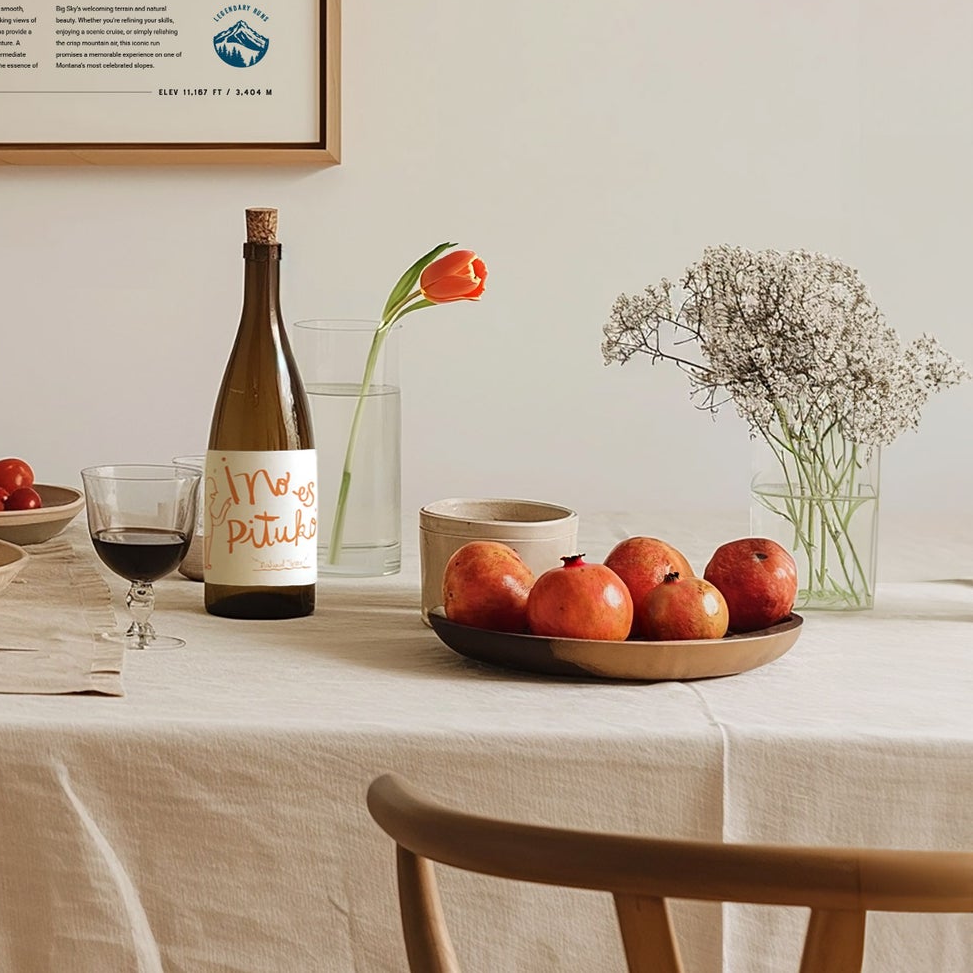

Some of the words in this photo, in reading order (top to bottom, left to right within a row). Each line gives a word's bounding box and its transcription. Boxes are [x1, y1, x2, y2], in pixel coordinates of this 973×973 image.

[213, 4, 251, 22] LEGENDARY
[252, 7, 270, 22] RUNS
[55, 17, 77, 25] beauty.
[103, 17, 121, 25] you're
[158, 88, 179, 96] ELEV
[212, 88, 222, 96] FT
[235, 88, 262, 96] 3,404
[265, 88, 273, 96] M
